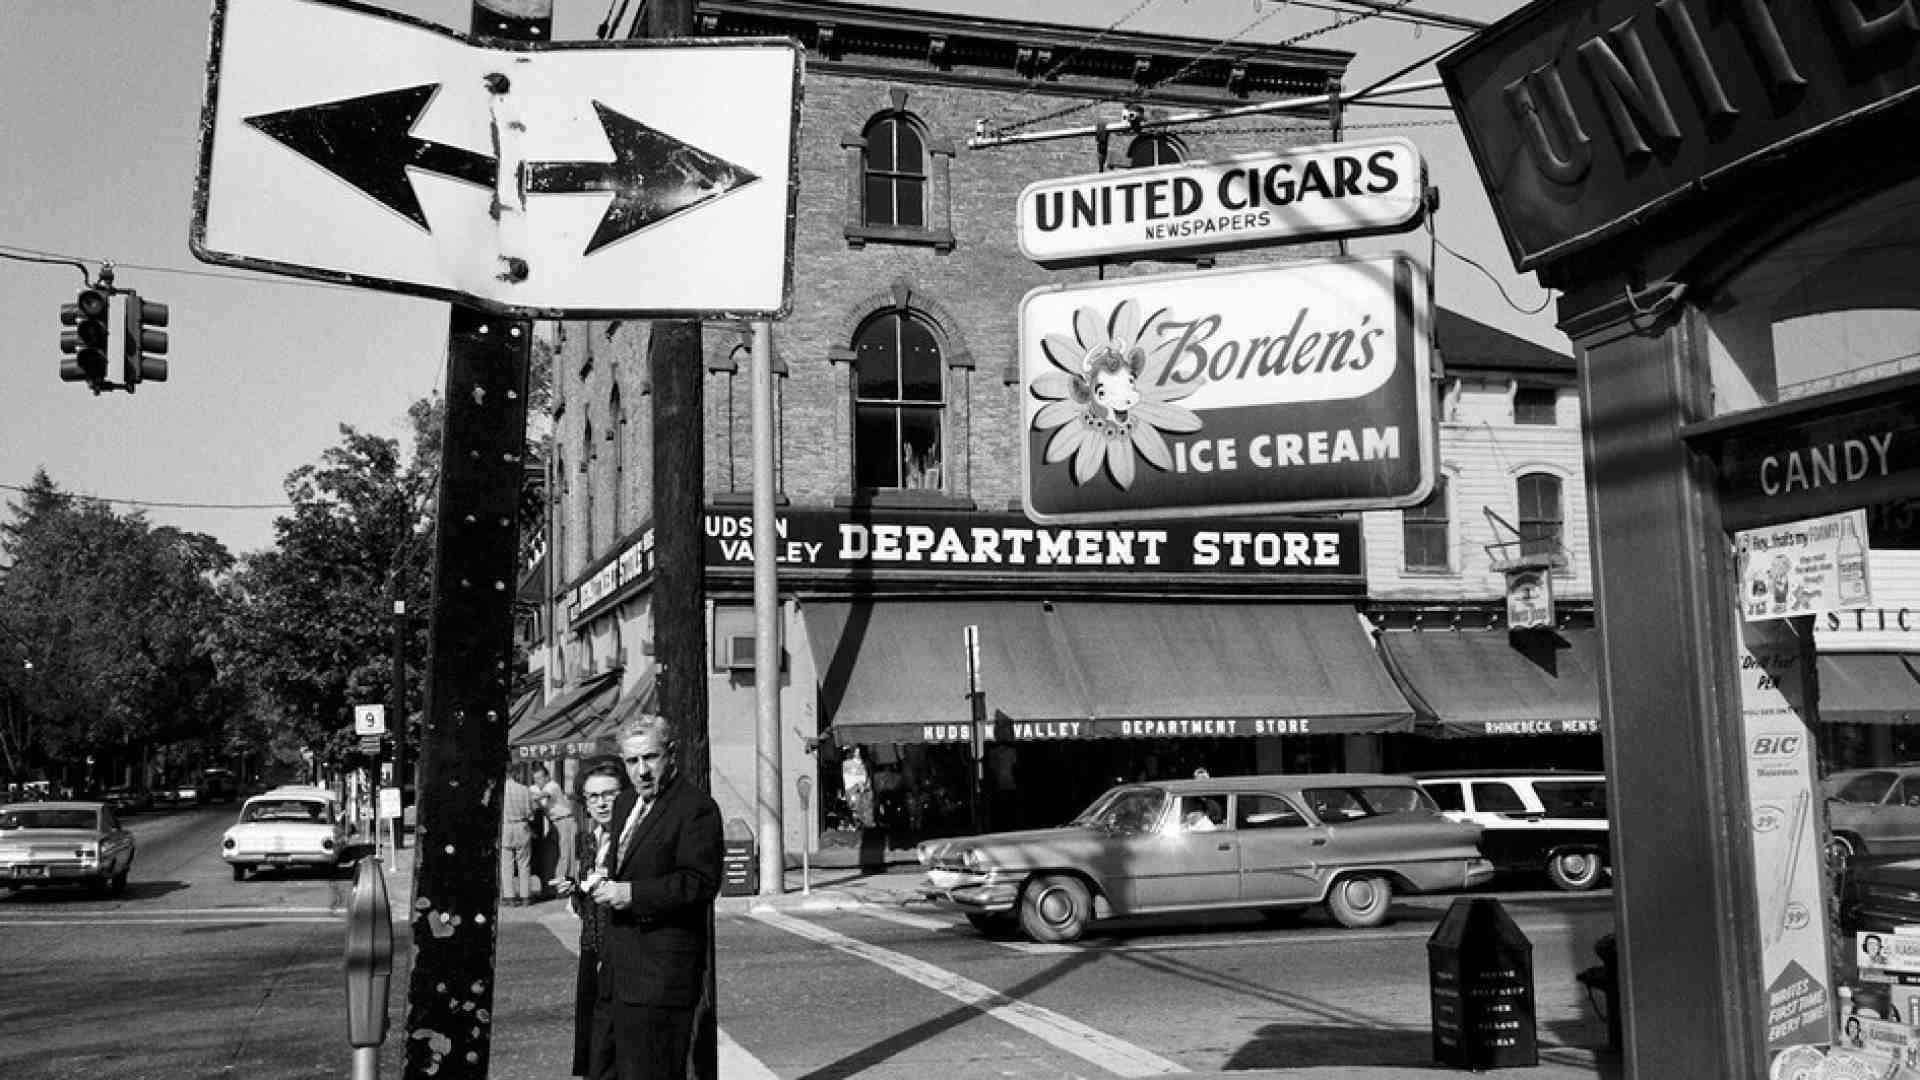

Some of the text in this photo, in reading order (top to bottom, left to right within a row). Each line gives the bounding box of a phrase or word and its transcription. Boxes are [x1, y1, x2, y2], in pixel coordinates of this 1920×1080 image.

[1035, 150, 1399, 232] UNITED CIGARS
[1144, 210, 1272, 240] NEWSPAPERS
[1154, 307, 1385, 387] Borden's
[1174, 425, 1401, 474] ICE CREAM
[1760, 431, 1894, 497] CANDY
[719, 539, 823, 563] VAEY
[838, 523, 1341, 567] DEPARTMENT STORE
[365, 711, 375, 728] 9
[923, 718, 1310, 741] HUDSN VALLEY DEPARTMENT STORE
[1562, 719, 1598, 732] MEN'S
